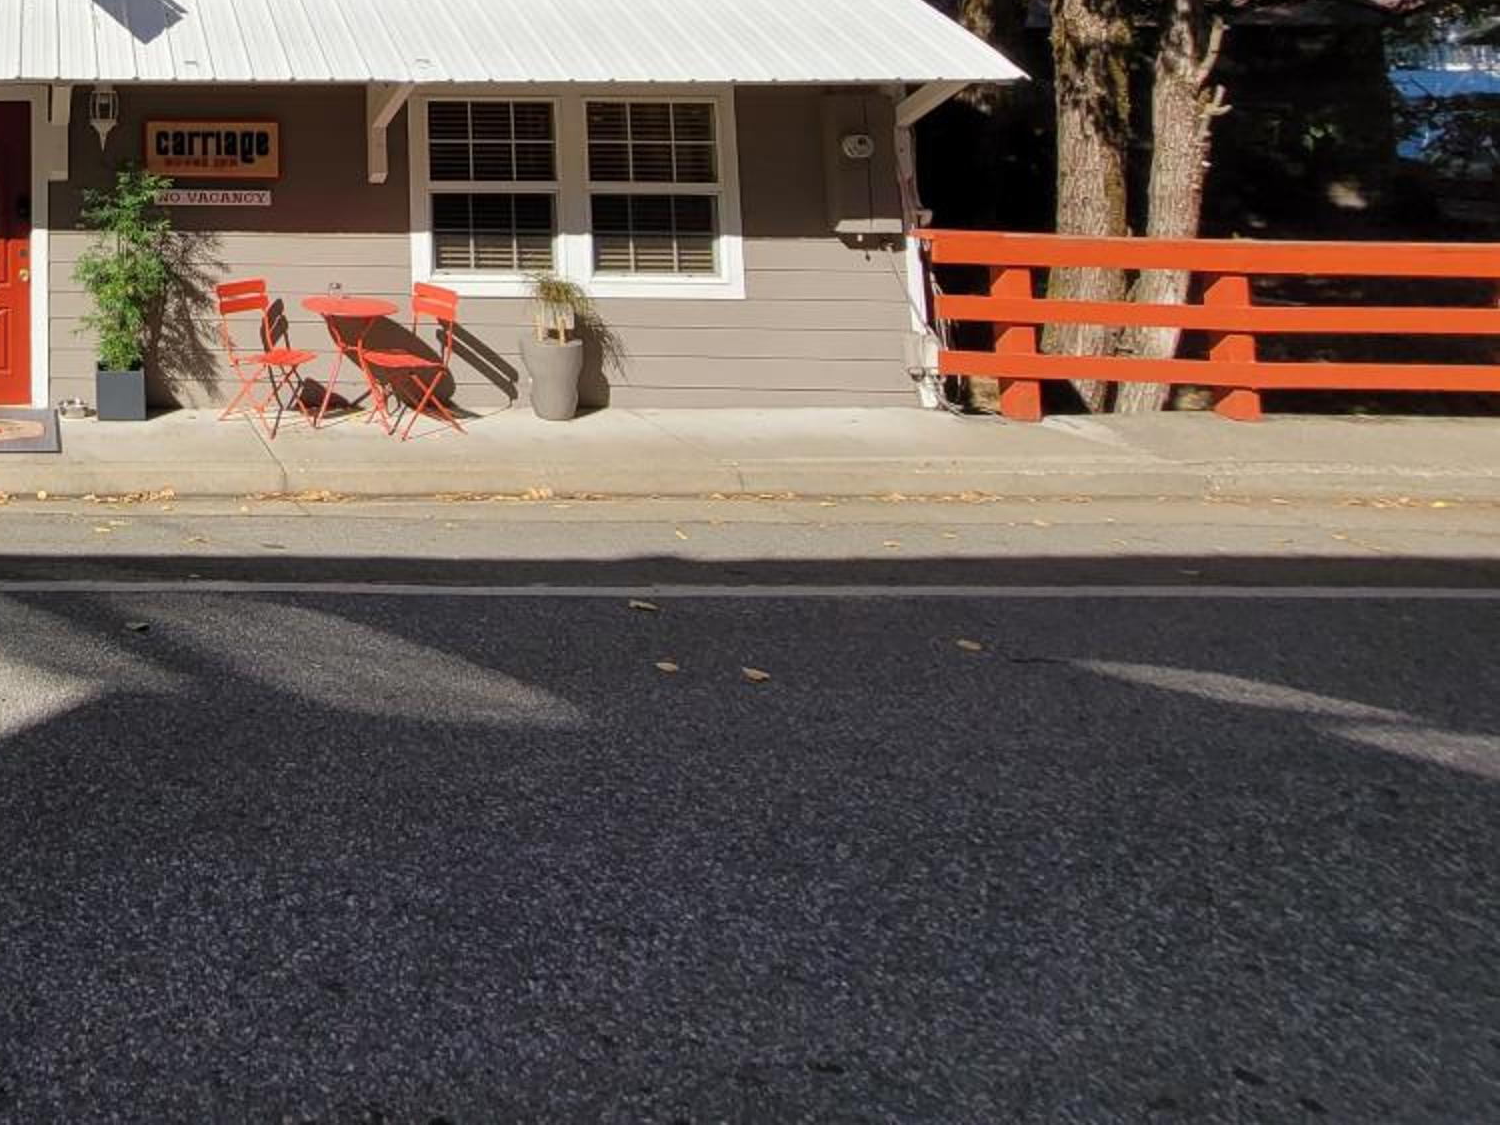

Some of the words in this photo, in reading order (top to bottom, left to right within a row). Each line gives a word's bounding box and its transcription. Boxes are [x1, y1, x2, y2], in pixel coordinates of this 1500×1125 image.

[155, 131, 269, 164] carriage
[158, 193, 181, 204] NO
[188, 192, 267, 205] VACANCY
